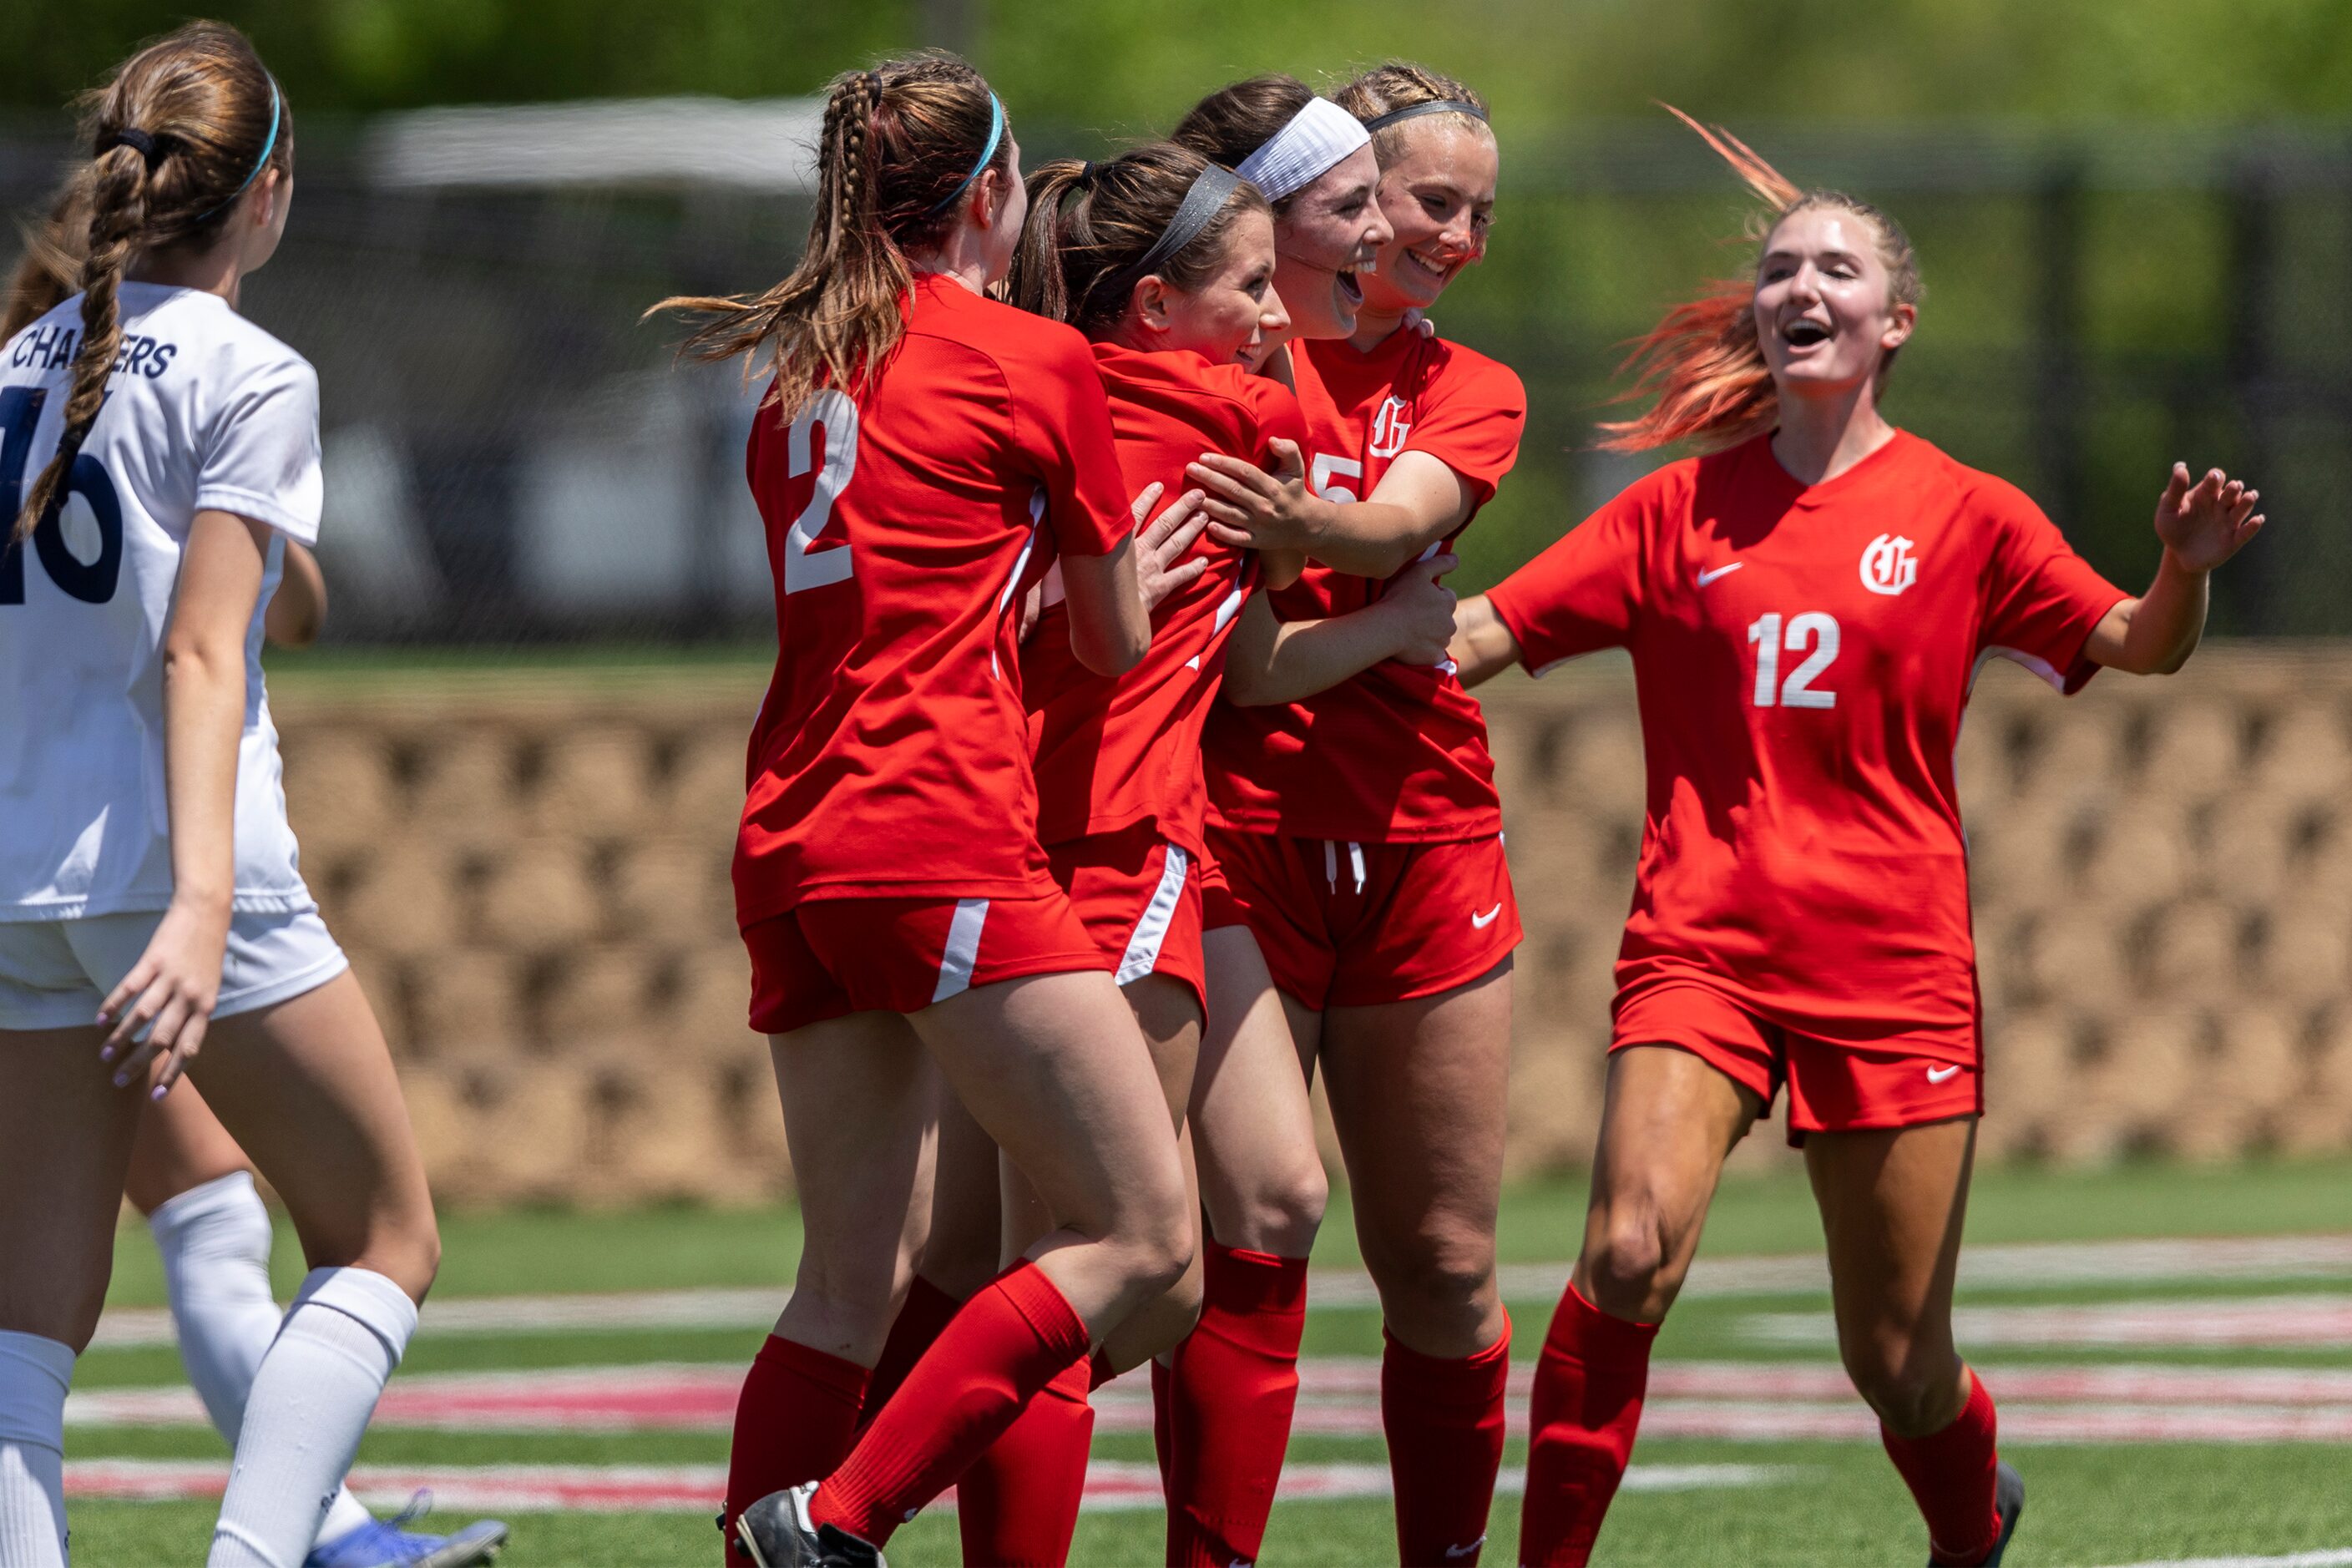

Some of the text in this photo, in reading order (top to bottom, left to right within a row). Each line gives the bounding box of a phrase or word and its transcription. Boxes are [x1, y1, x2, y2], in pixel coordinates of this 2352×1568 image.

[0, 386, 123, 604] 16
[785, 389, 859, 595] 2
[1859, 533, 1918, 595] G
[1748, 611, 1841, 709] 12
